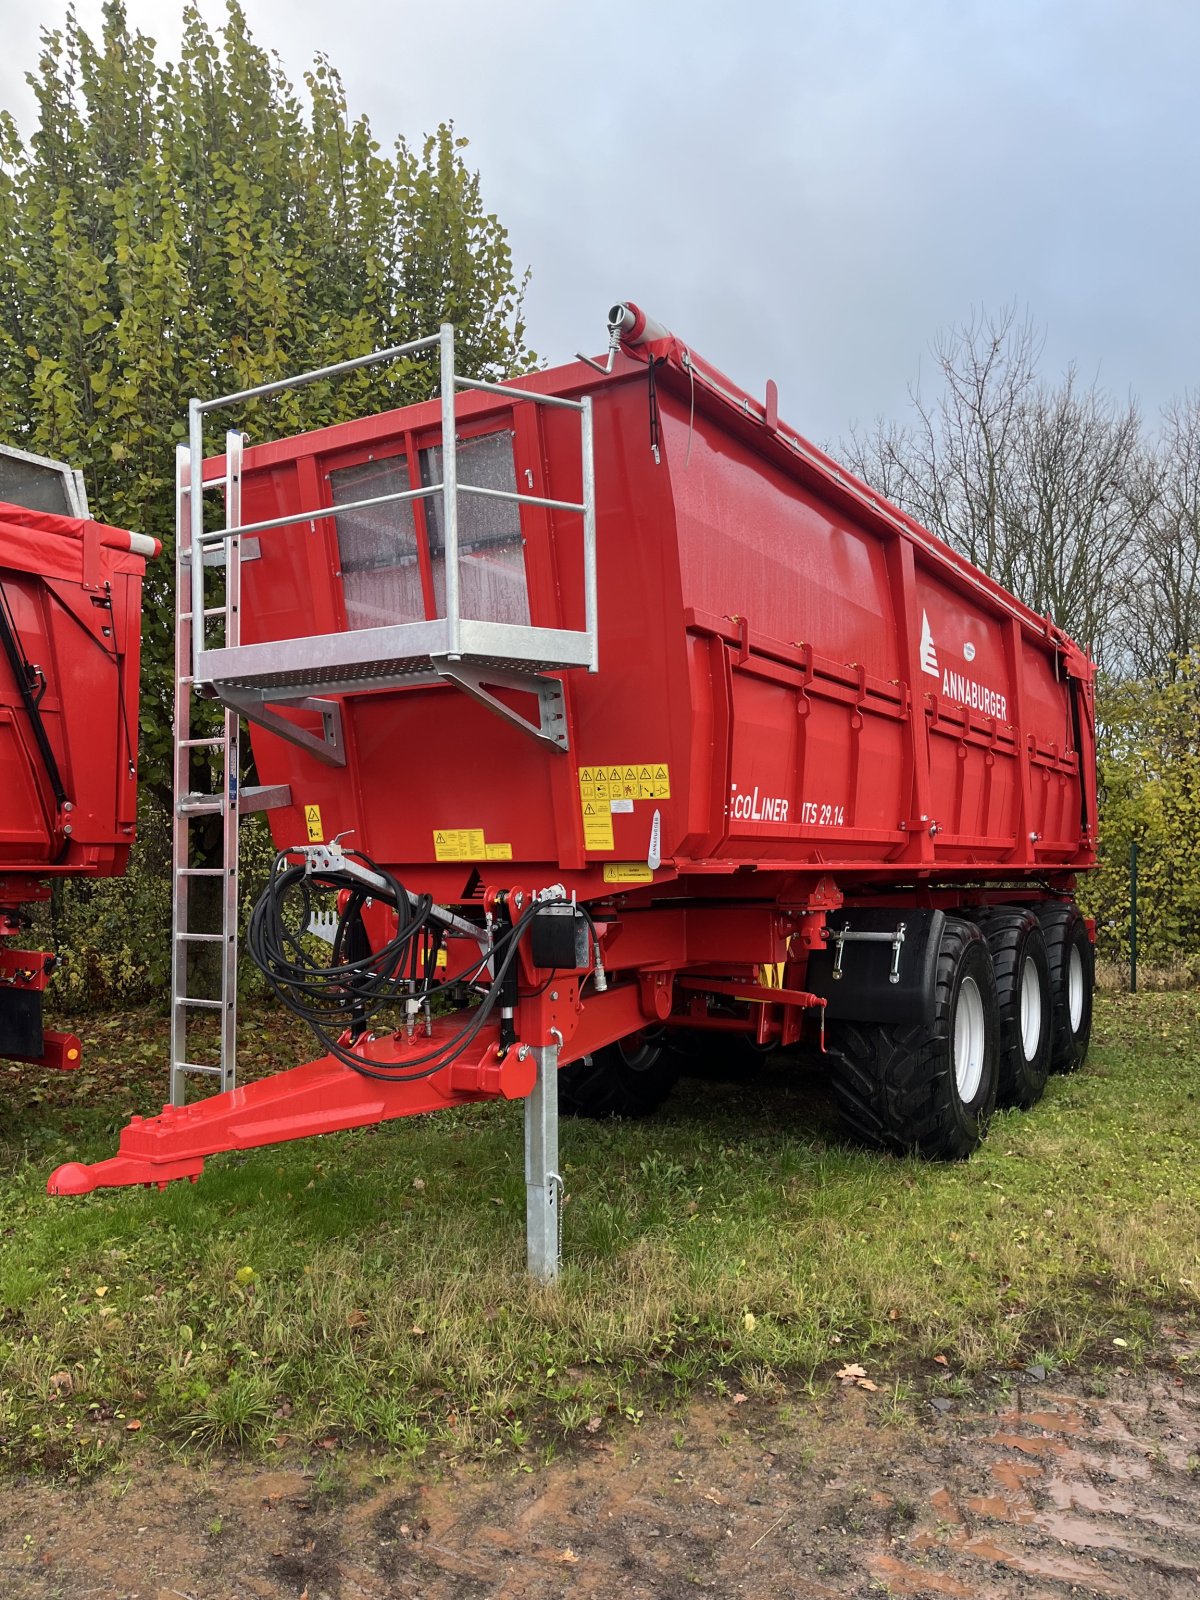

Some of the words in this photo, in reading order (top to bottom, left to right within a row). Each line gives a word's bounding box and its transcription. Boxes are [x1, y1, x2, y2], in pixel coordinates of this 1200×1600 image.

[942, 668, 1007, 722] ANNABURGER
[801, 802, 818, 824] ITS
[819, 804, 844, 826] 29.14
